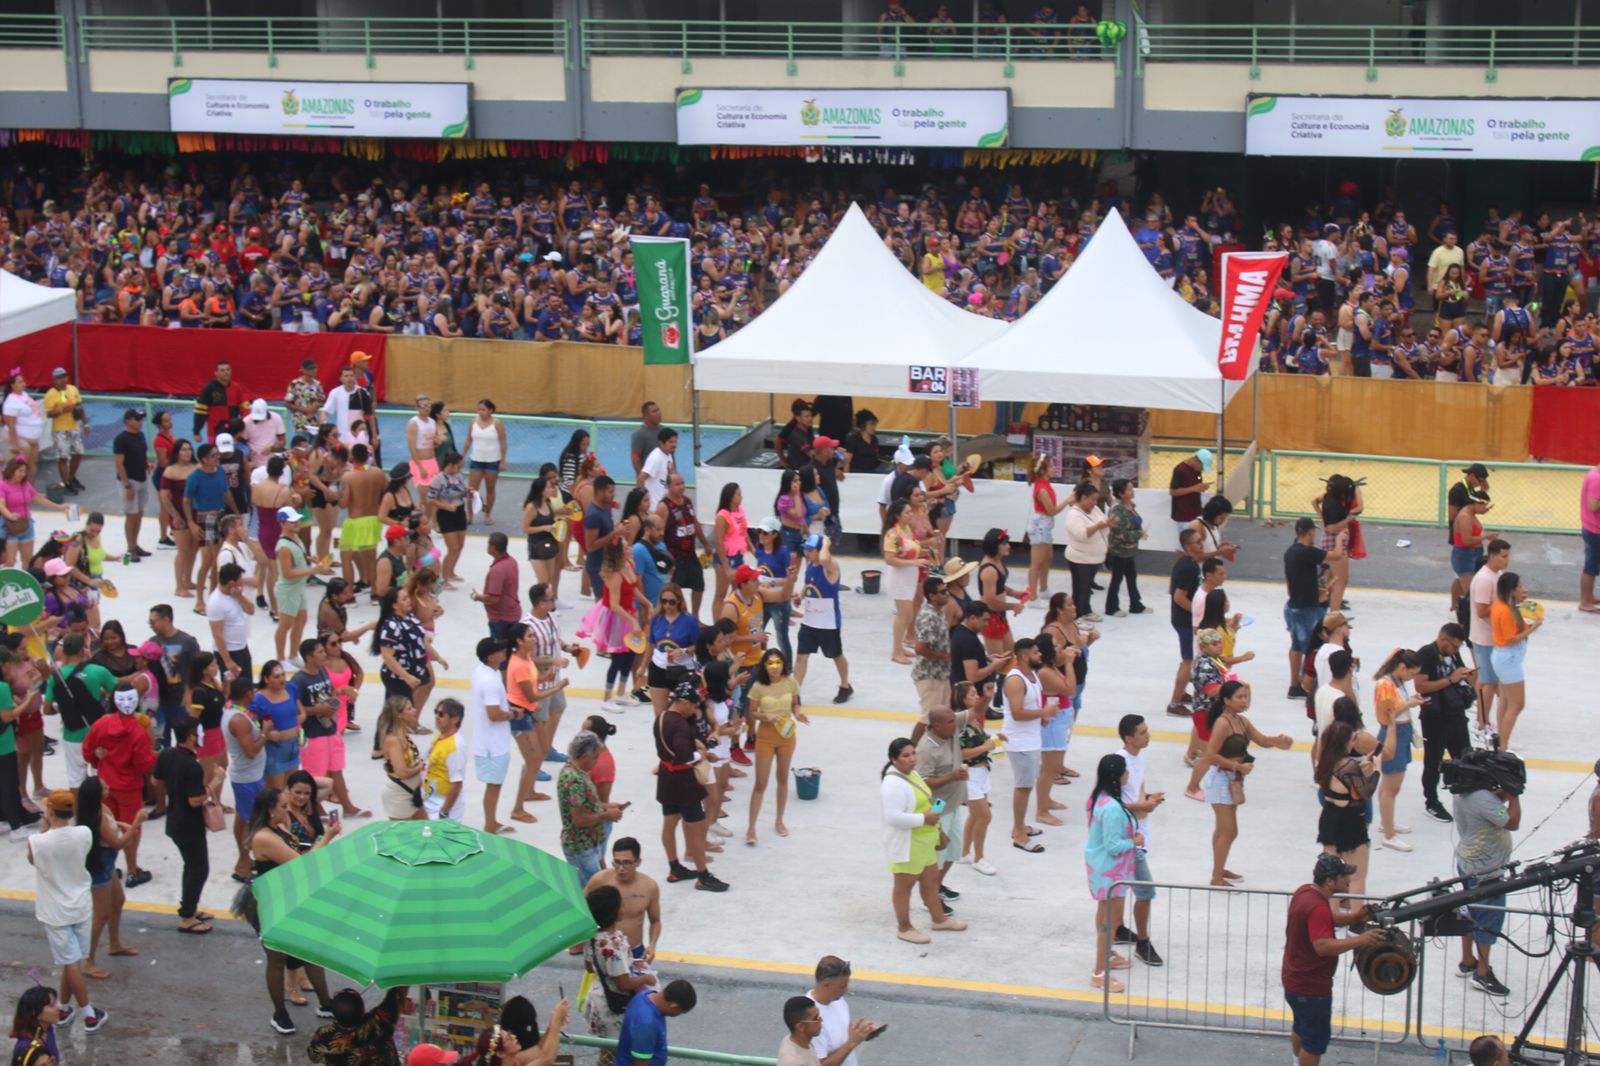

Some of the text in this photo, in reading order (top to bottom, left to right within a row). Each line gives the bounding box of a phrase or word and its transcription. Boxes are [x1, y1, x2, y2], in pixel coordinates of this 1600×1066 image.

[205, 101, 230, 109] Cultura
[237, 102, 270, 110] Economia
[301, 97, 355, 116] AMAZONAS
[363, 98, 412, 109] O trabalho
[383, 109, 404, 120] pela
[405, 111, 432, 120] gente
[716, 112, 744, 120] Cultura
[751, 112, 787, 120] Economia
[822, 106, 881, 126] AMAZONAS
[891, 107, 945, 118] O trabalho
[716, 121, 746, 129] Criativa
[913, 119, 936, 130] pela
[937, 119, 967, 130] gente
[1290, 121, 1321, 130] Cultura
[1329, 122, 1370, 131] Economia
[1408, 116, 1475, 137] AMAZONAS
[1486, 118, 1546, 129] O trabalho
[1290, 130, 1323, 139] Criativa
[1510, 130, 1536, 142] pela
[1537, 131, 1570, 143] gente
[655, 259, 679, 321] Guaraná
[910, 366, 946, 381] BAR
[931, 381, 946, 393] 04
